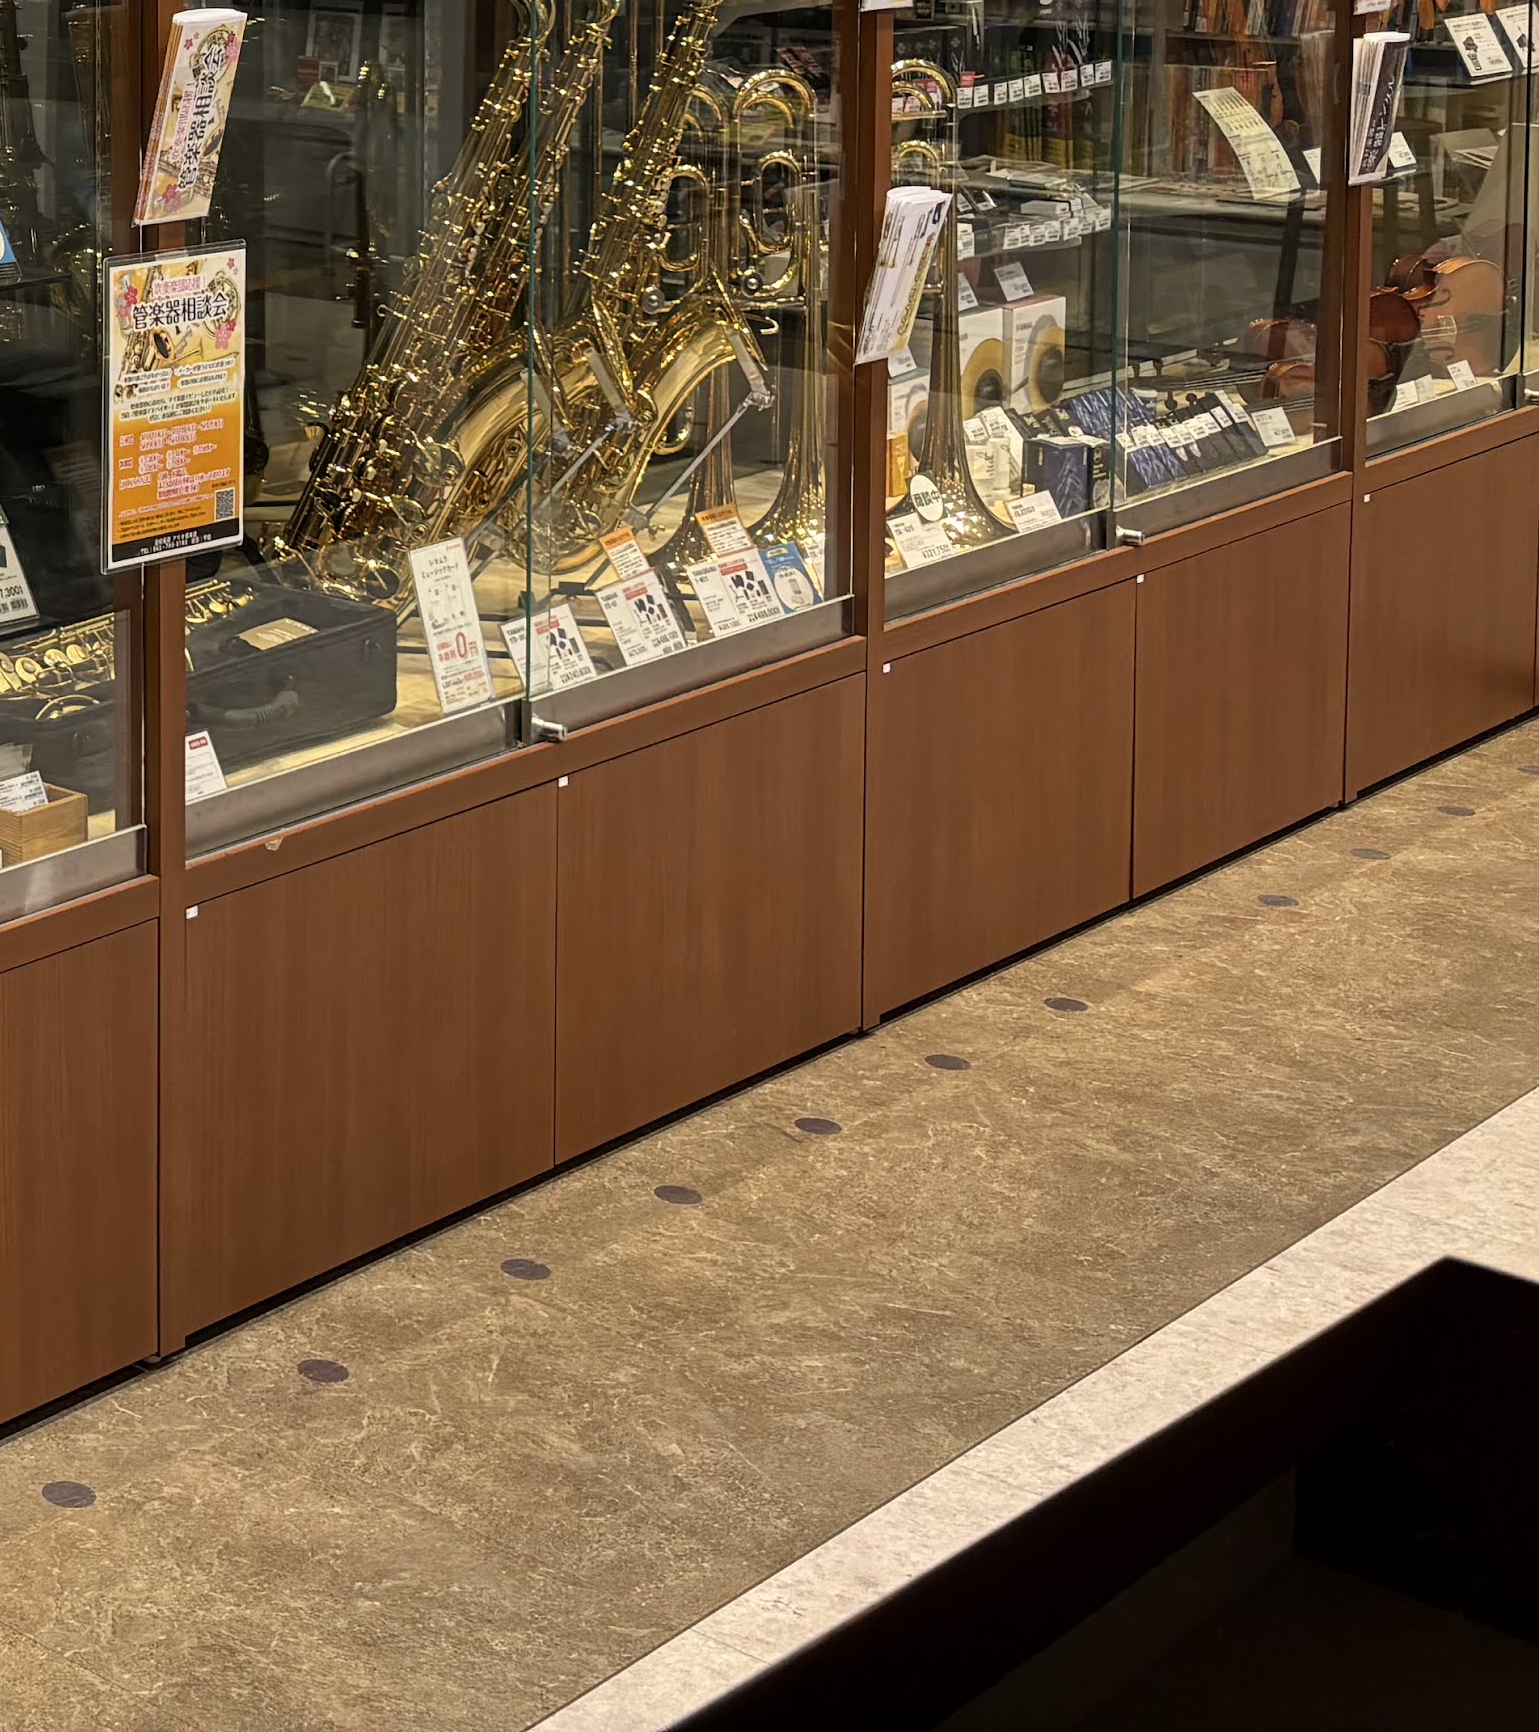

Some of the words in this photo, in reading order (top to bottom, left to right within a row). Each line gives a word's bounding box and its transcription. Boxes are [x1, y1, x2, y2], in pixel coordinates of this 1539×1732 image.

[178, 45, 224, 190] 管楽器相談会
[132, 291, 229, 330] 管楽器相談会
